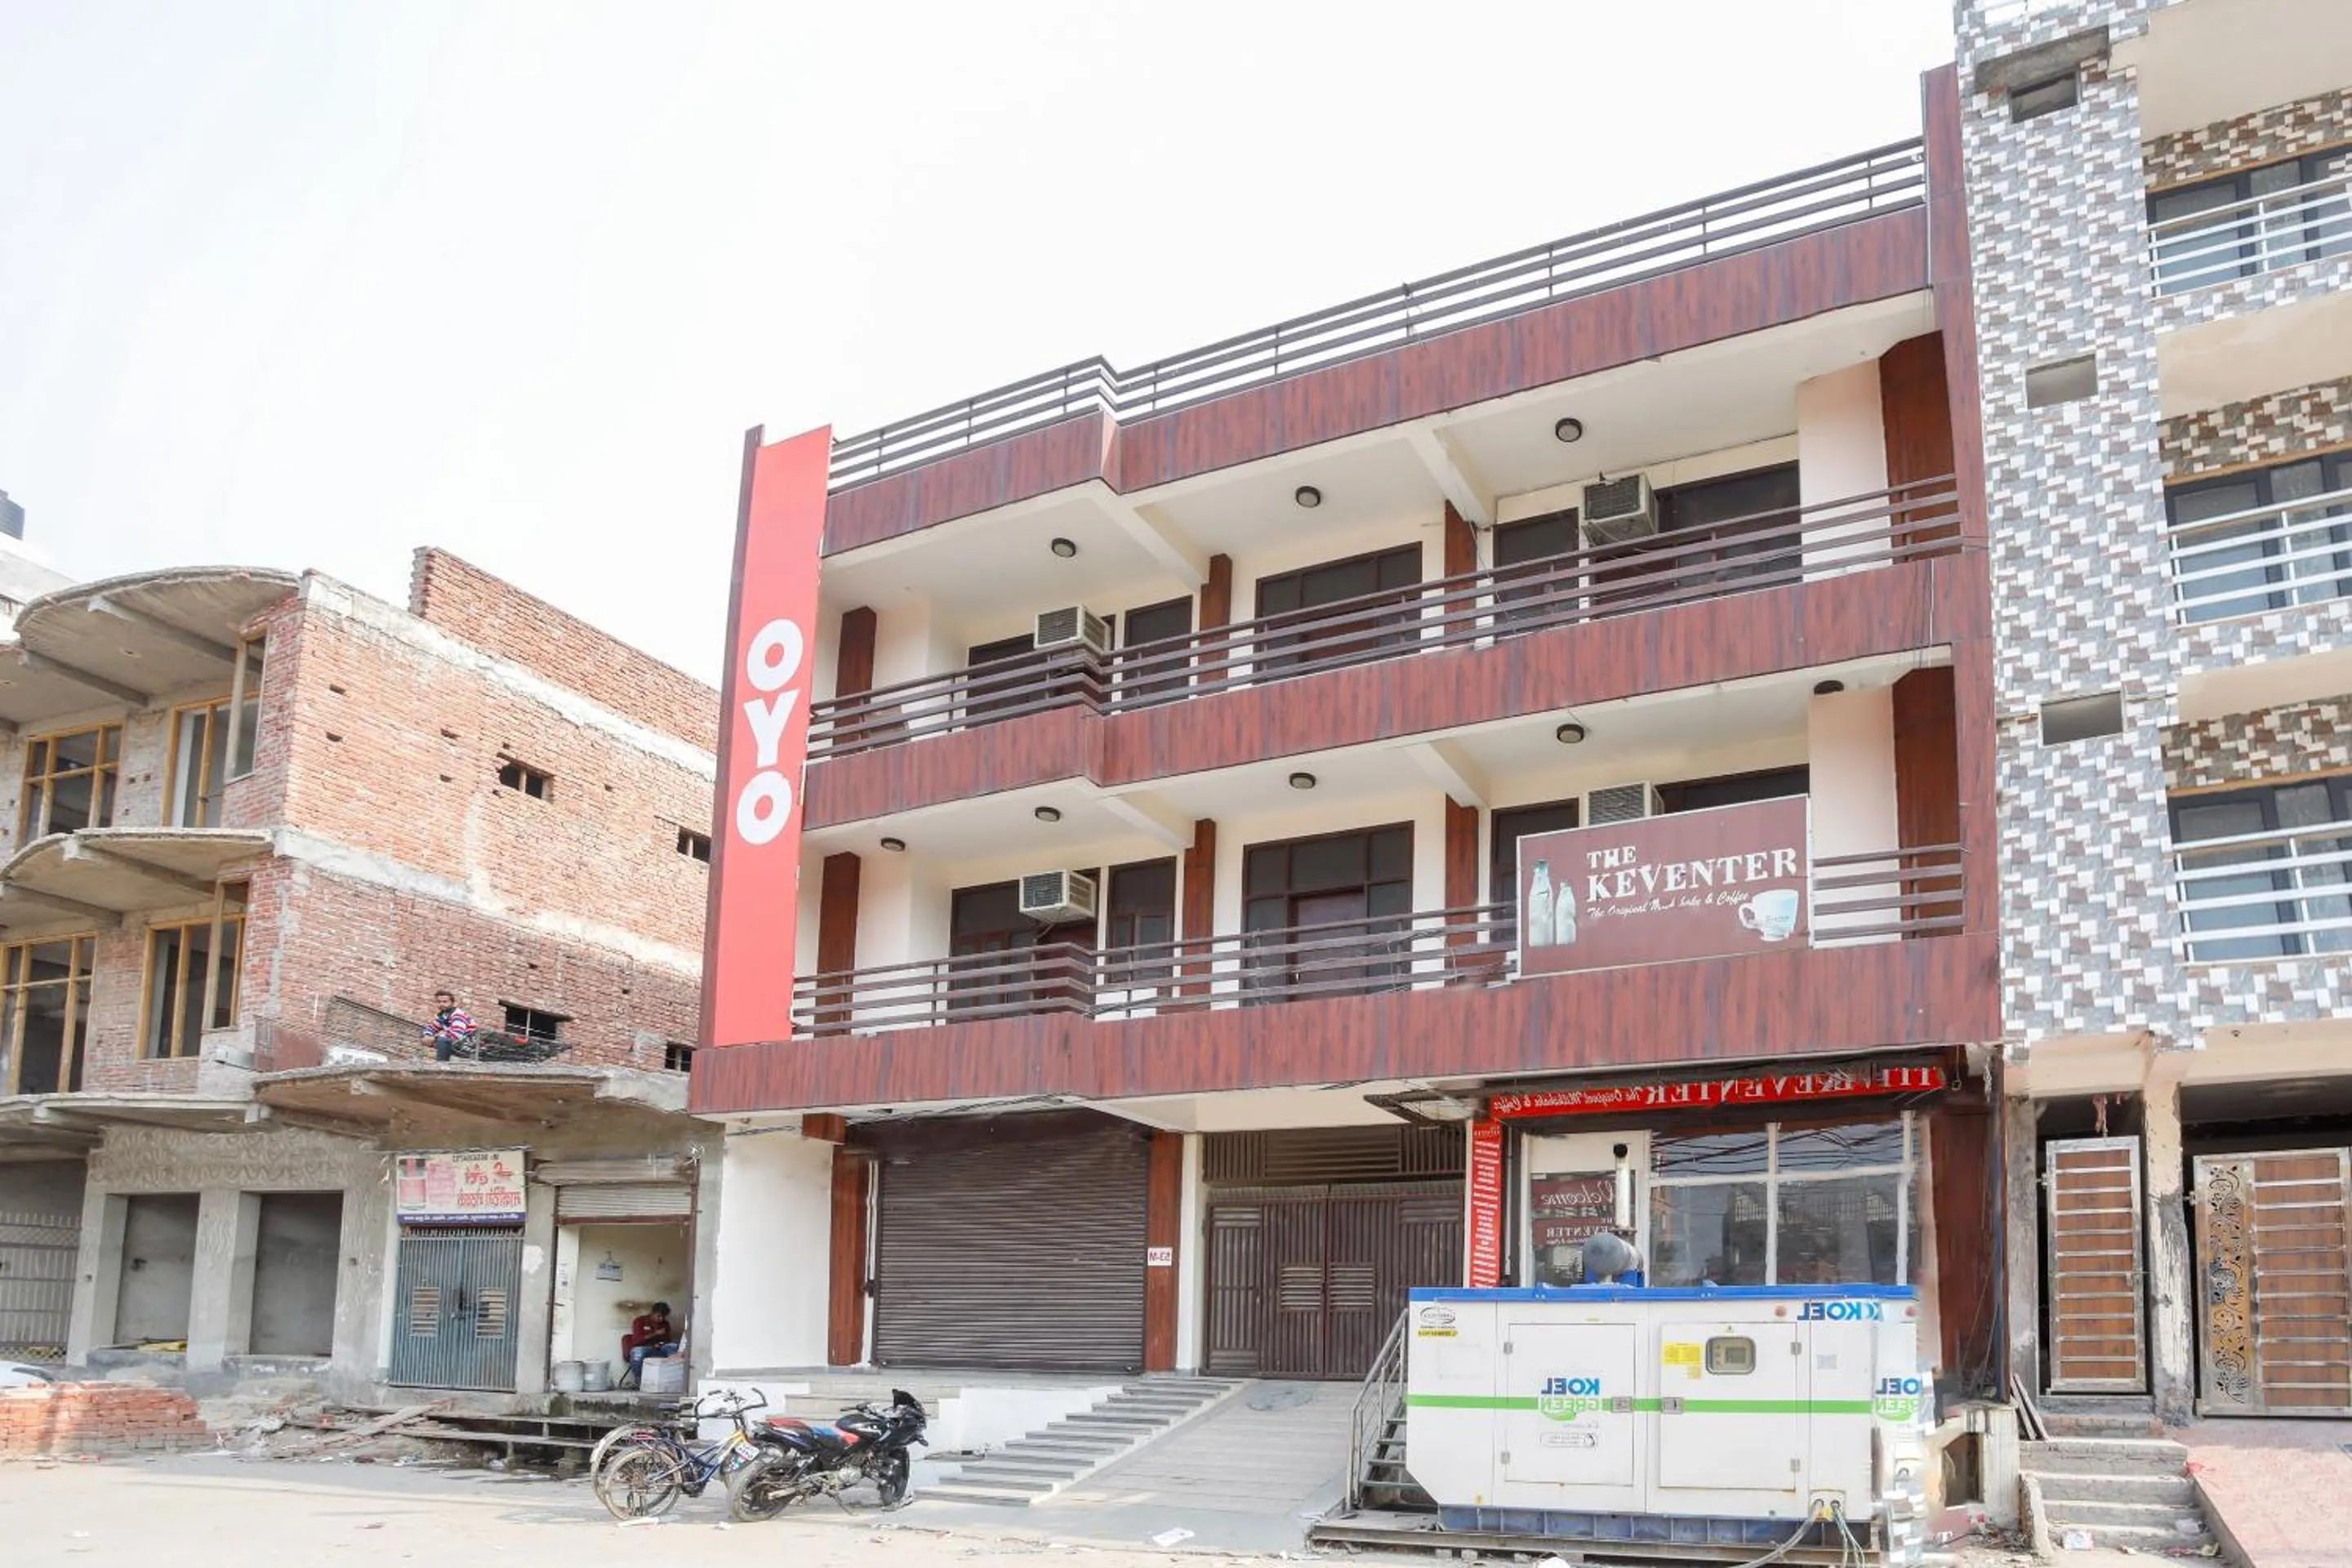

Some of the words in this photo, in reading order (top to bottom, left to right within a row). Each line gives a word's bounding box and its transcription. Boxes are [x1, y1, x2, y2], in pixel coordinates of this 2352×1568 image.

[736, 619, 803, 844] OYO
[1587, 845, 1637, 869] THE
[1587, 848, 1797, 902] KEVENTER
[1717, 890, 1749, 906] Coffee
